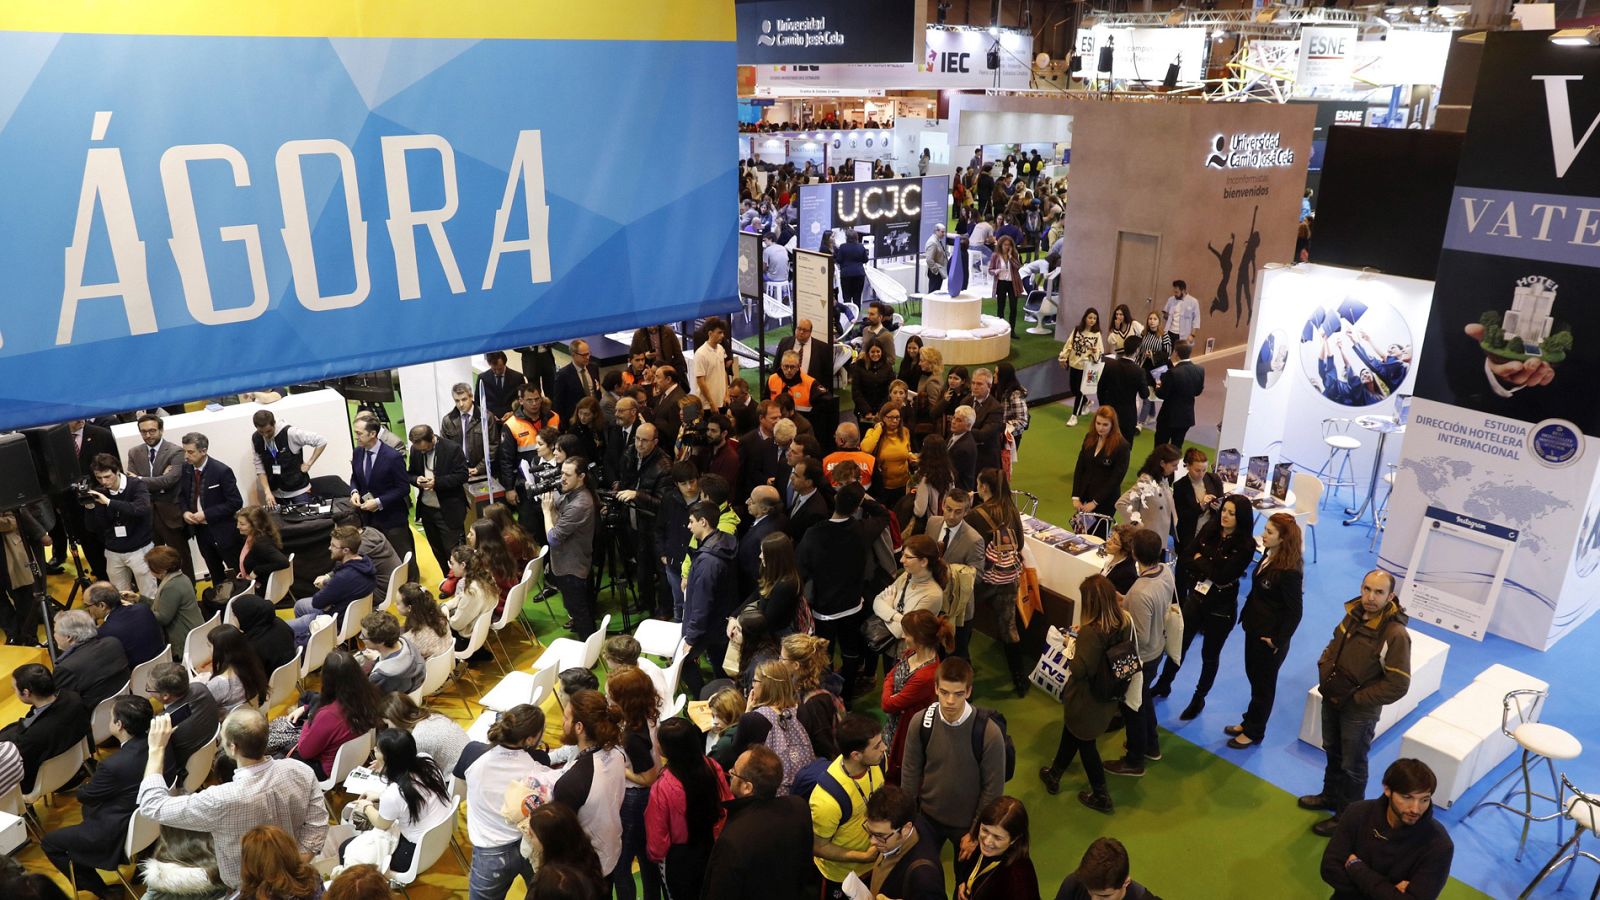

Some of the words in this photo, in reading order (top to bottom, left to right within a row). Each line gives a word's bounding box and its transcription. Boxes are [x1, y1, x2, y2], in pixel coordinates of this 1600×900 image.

[776, 16, 826, 32] Universidad
[776, 32, 804, 46] Camilo
[804, 31, 824, 48] José
[824, 31, 845, 45] Cela
[1308, 36, 1348, 55] ESNE
[941, 52, 970, 73] IEC
[1334, 111, 1364, 121] ESNE
[1531, 75, 1600, 178] V
[1229, 133, 1280, 150] Universidad
[1228, 149, 1258, 168] Camilo
[1276, 147, 1294, 164] Cela
[1223, 185, 1269, 199] bienvenidos
[836, 184, 921, 222] UCJC
[55, 111, 552, 345] ÁGORA
[1460, 197, 1600, 247] VATE
[1416, 414, 1467, 435] DIRECCIÓN
[1469, 427, 1523, 448] HOTELERA
[1484, 419, 1527, 437] ESTUDIA
[1437, 432, 1520, 460] INTERNACIONAL
[1456, 515, 1487, 530] Instagram
